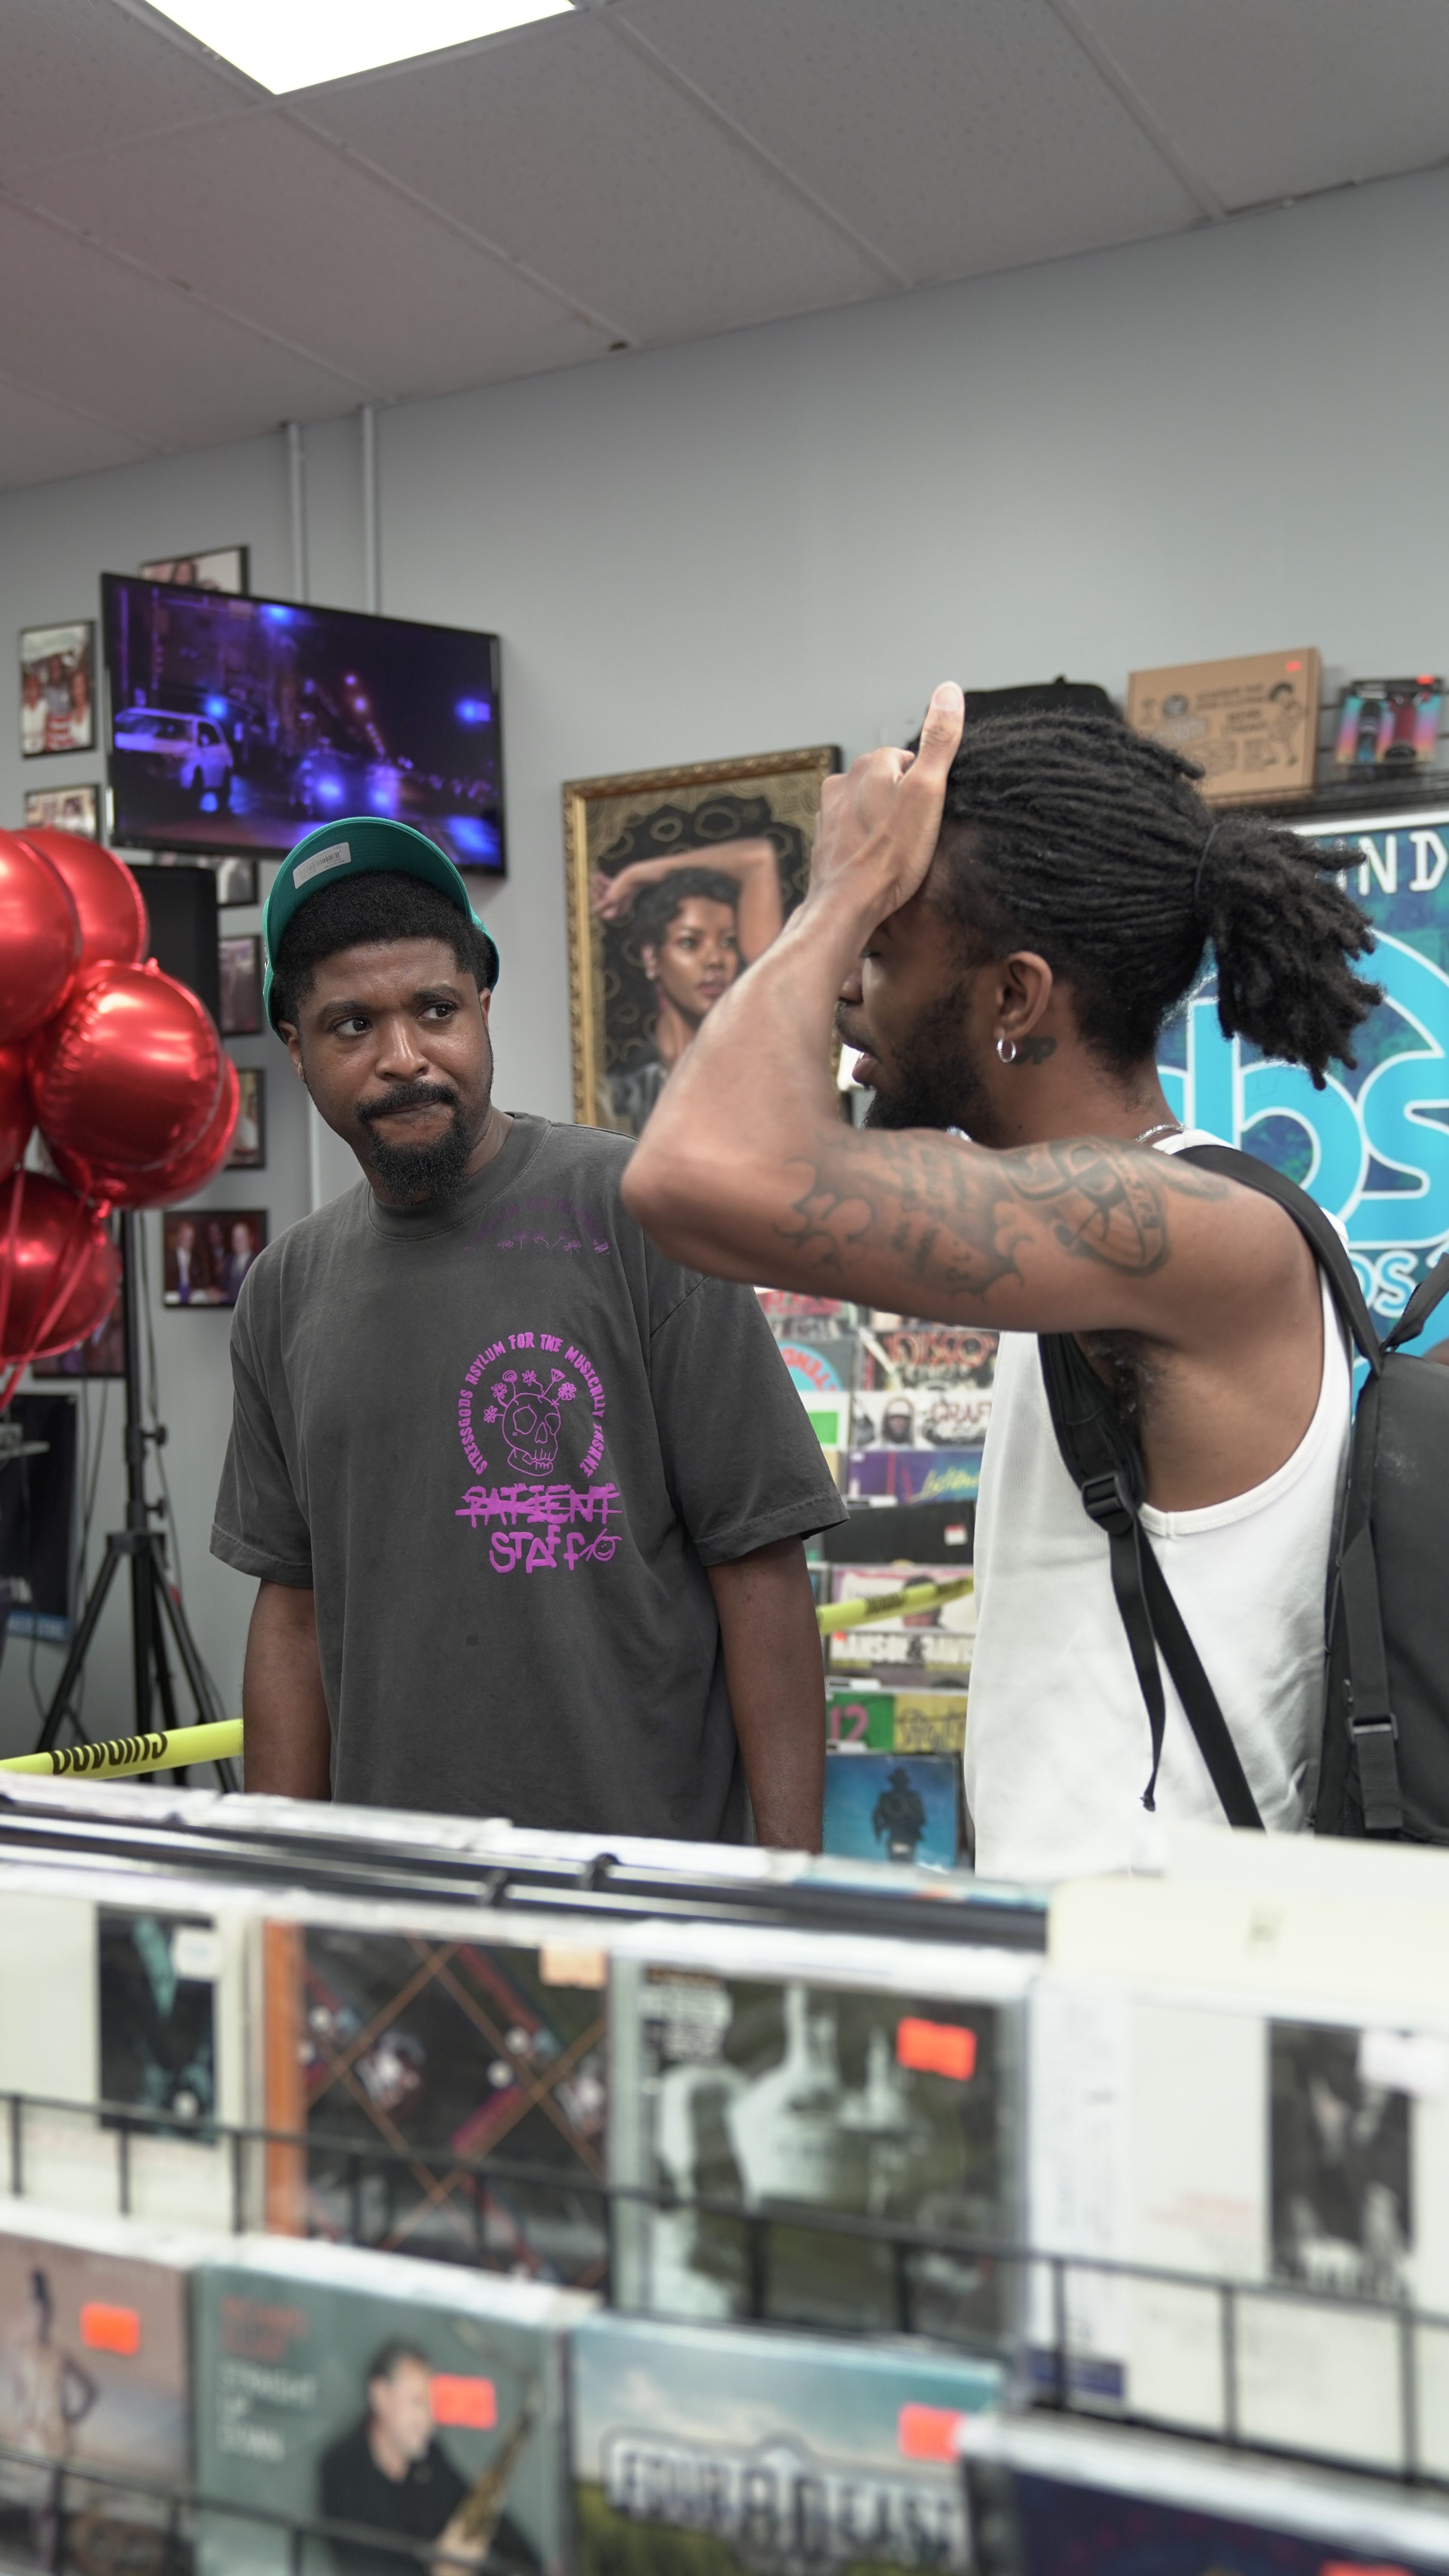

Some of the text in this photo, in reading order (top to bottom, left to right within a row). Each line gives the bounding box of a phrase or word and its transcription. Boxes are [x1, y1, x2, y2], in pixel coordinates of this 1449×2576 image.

[465, 1341, 506, 1385] ASYLUM
[508, 1332, 535, 1350] FOR
[540, 1334, 564, 1353] THE
[564, 1346, 605, 1418] MUSICALLY
[458, 1389, 488, 1475] STRESSGODS
[489, 1524, 586, 1574] STAFF
